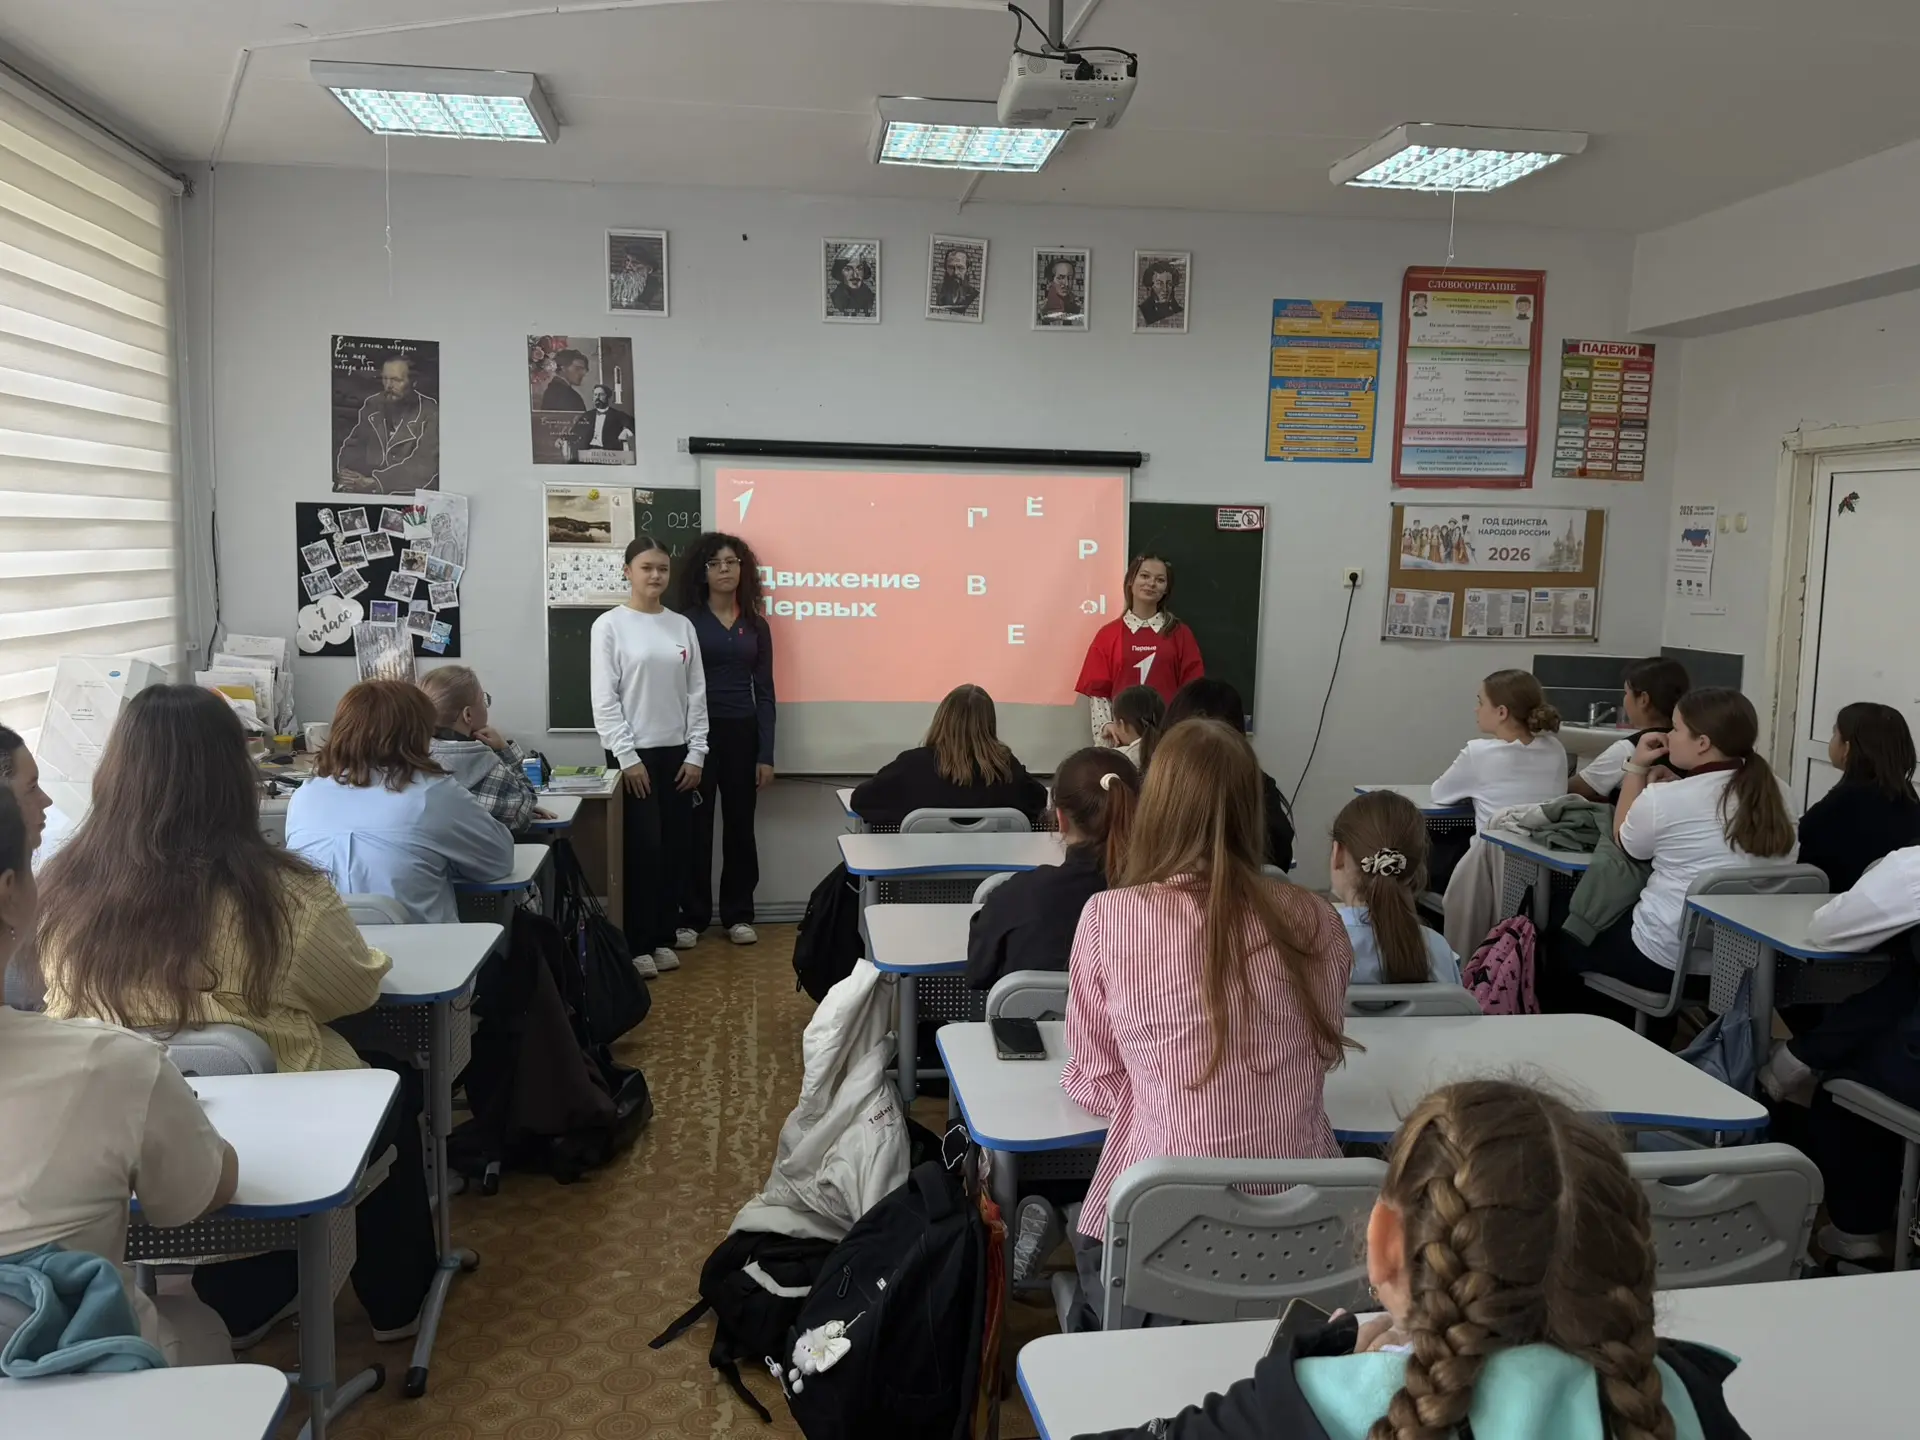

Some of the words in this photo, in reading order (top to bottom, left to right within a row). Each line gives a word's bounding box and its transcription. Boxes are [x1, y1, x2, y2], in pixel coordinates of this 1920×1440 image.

[1428, 280, 1517, 291] СЛОВОСОЧЕТАНИЕ
[1582, 343, 1637, 355] ПАДЕЖИ
[1482, 518, 1500, 526] ГОД
[1501, 518, 1548, 526] ЕДИНСТВА
[1478, 528, 1517, 537] НАРОДОВ
[1078, 539, 1099, 560] Р
[1488, 547, 1531, 561] 2026
[757, 566, 921, 590] Движение
[966, 574, 988, 596] В
[315, 607, 327, 620] 7
[308, 609, 353, 642] класс
[1007, 624, 1026, 645] Е
[1131, 645, 1158, 653] Первые
